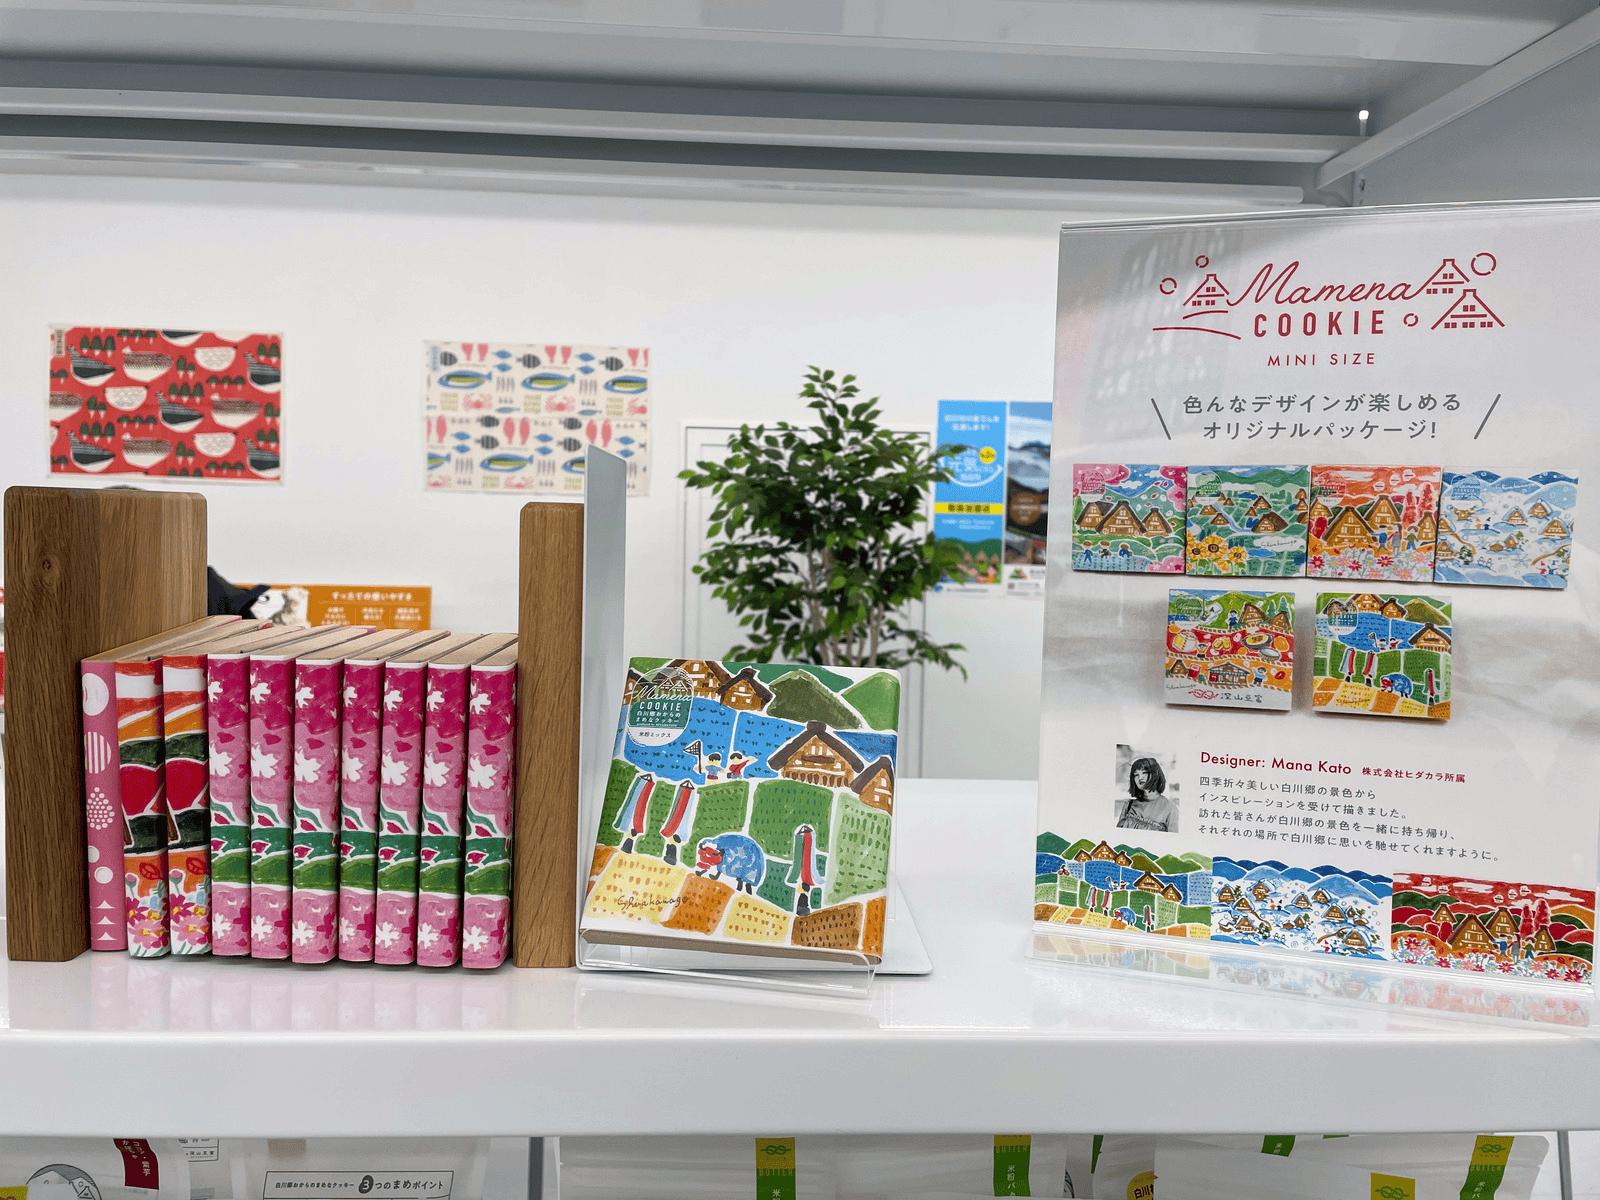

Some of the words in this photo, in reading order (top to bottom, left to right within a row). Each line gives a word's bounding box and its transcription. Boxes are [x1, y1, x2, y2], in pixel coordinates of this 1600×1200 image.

[1227, 261, 1422, 306] Mamena
[1254, 310, 1384, 337] COOKIE
[1267, 354, 1316, 367] MINI
[1329, 352, 1375, 365] SIZE
[1183, 393, 1461, 414] 色んなデザインが楽しめる
[639, 701, 681, 711] COOKIE
[1200, 751, 1266, 769] Designer:
[1271, 757, 1313, 772] Mana
[1318, 760, 1352, 775] Kato
[1361, 766, 1466, 784] 株式会社ヒダカラ所属
[1199, 776, 1376, 800] 四季折々美しい白川郷の景色から
[1199, 792, 1407, 820] インスピレーションを受けて描きました。
[1198, 807, 1455, 840] 訪れた皆さんが白川郷の景色を一緒に持ち帰り、
[1198, 824, 1499, 862] それぞれの場所で白川郷に思いを馳せてくれますように。
